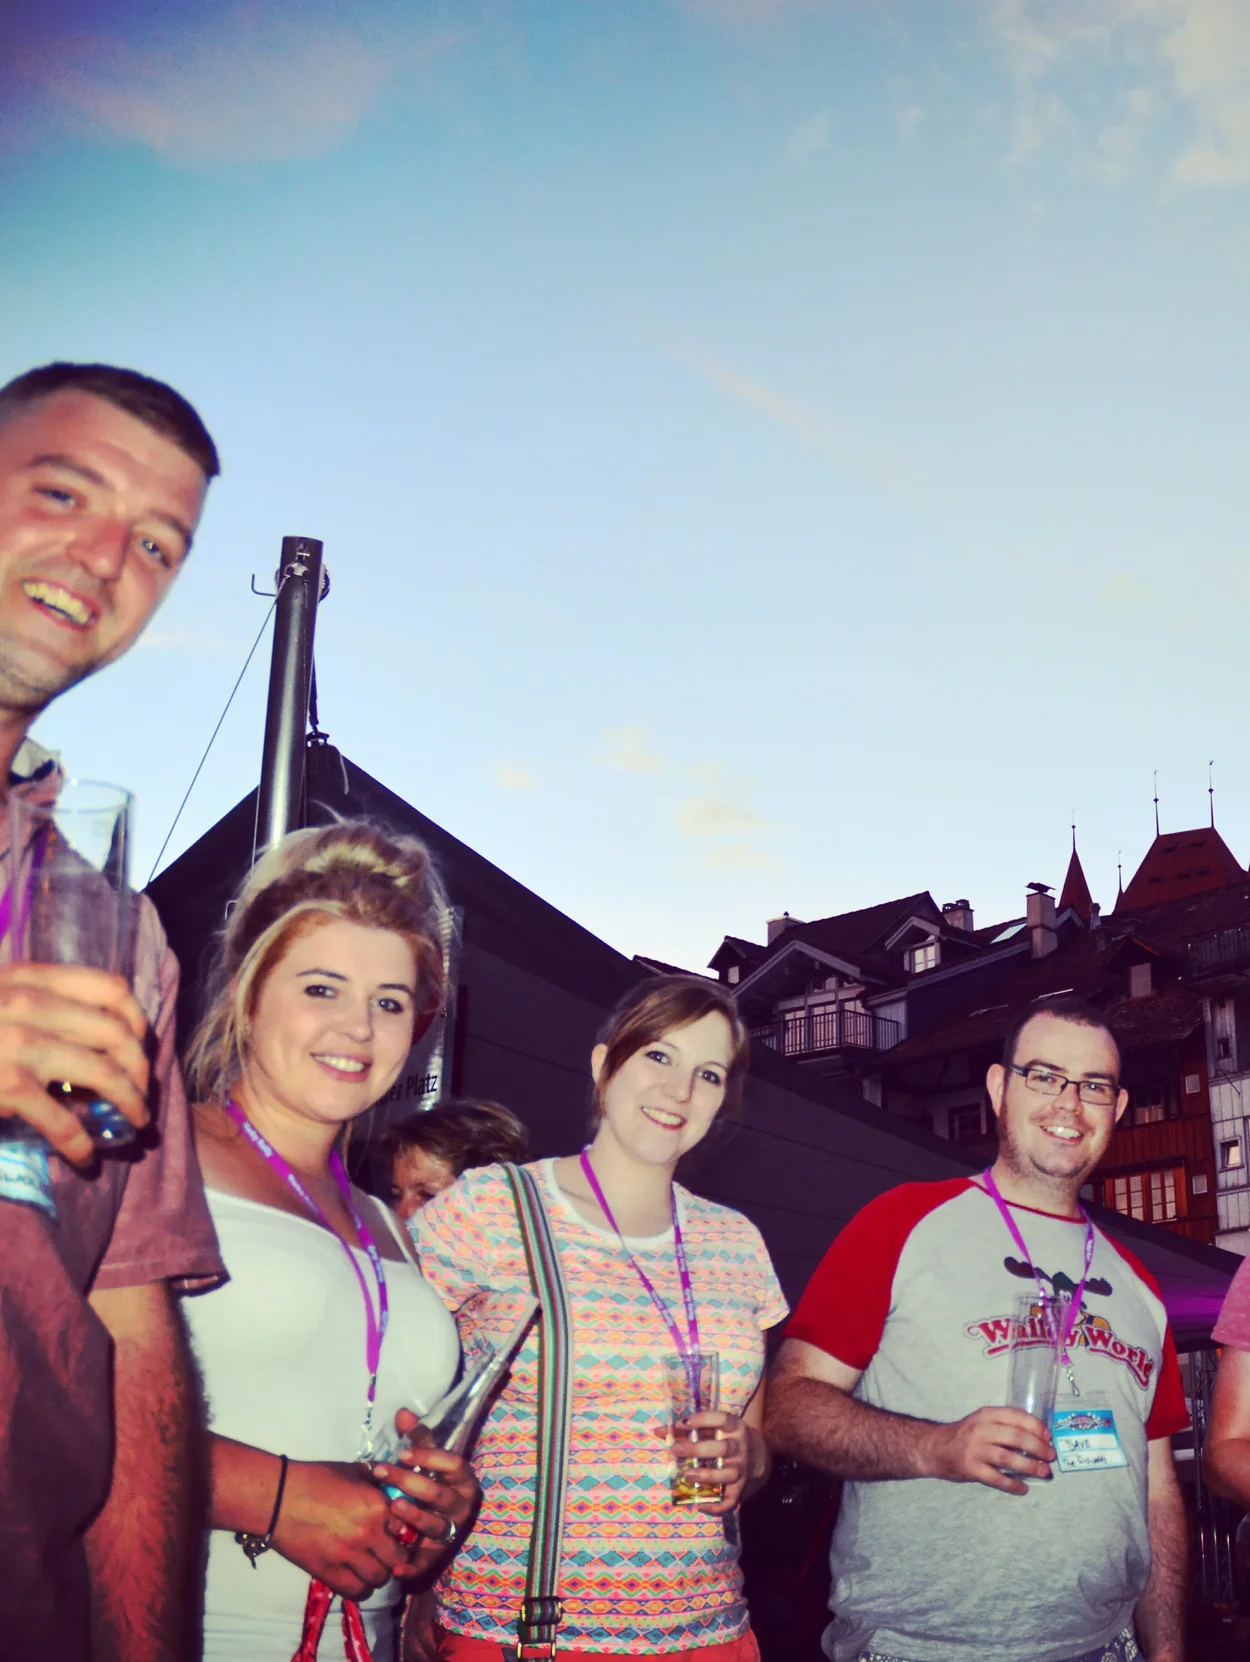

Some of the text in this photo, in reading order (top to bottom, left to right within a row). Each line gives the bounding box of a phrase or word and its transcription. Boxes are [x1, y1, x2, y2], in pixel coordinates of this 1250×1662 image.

[406, 1073, 438, 1099] Platz
[966, 1317, 1080, 1348] Wally
[1066, 1439, 1092, 1452] DAVE
